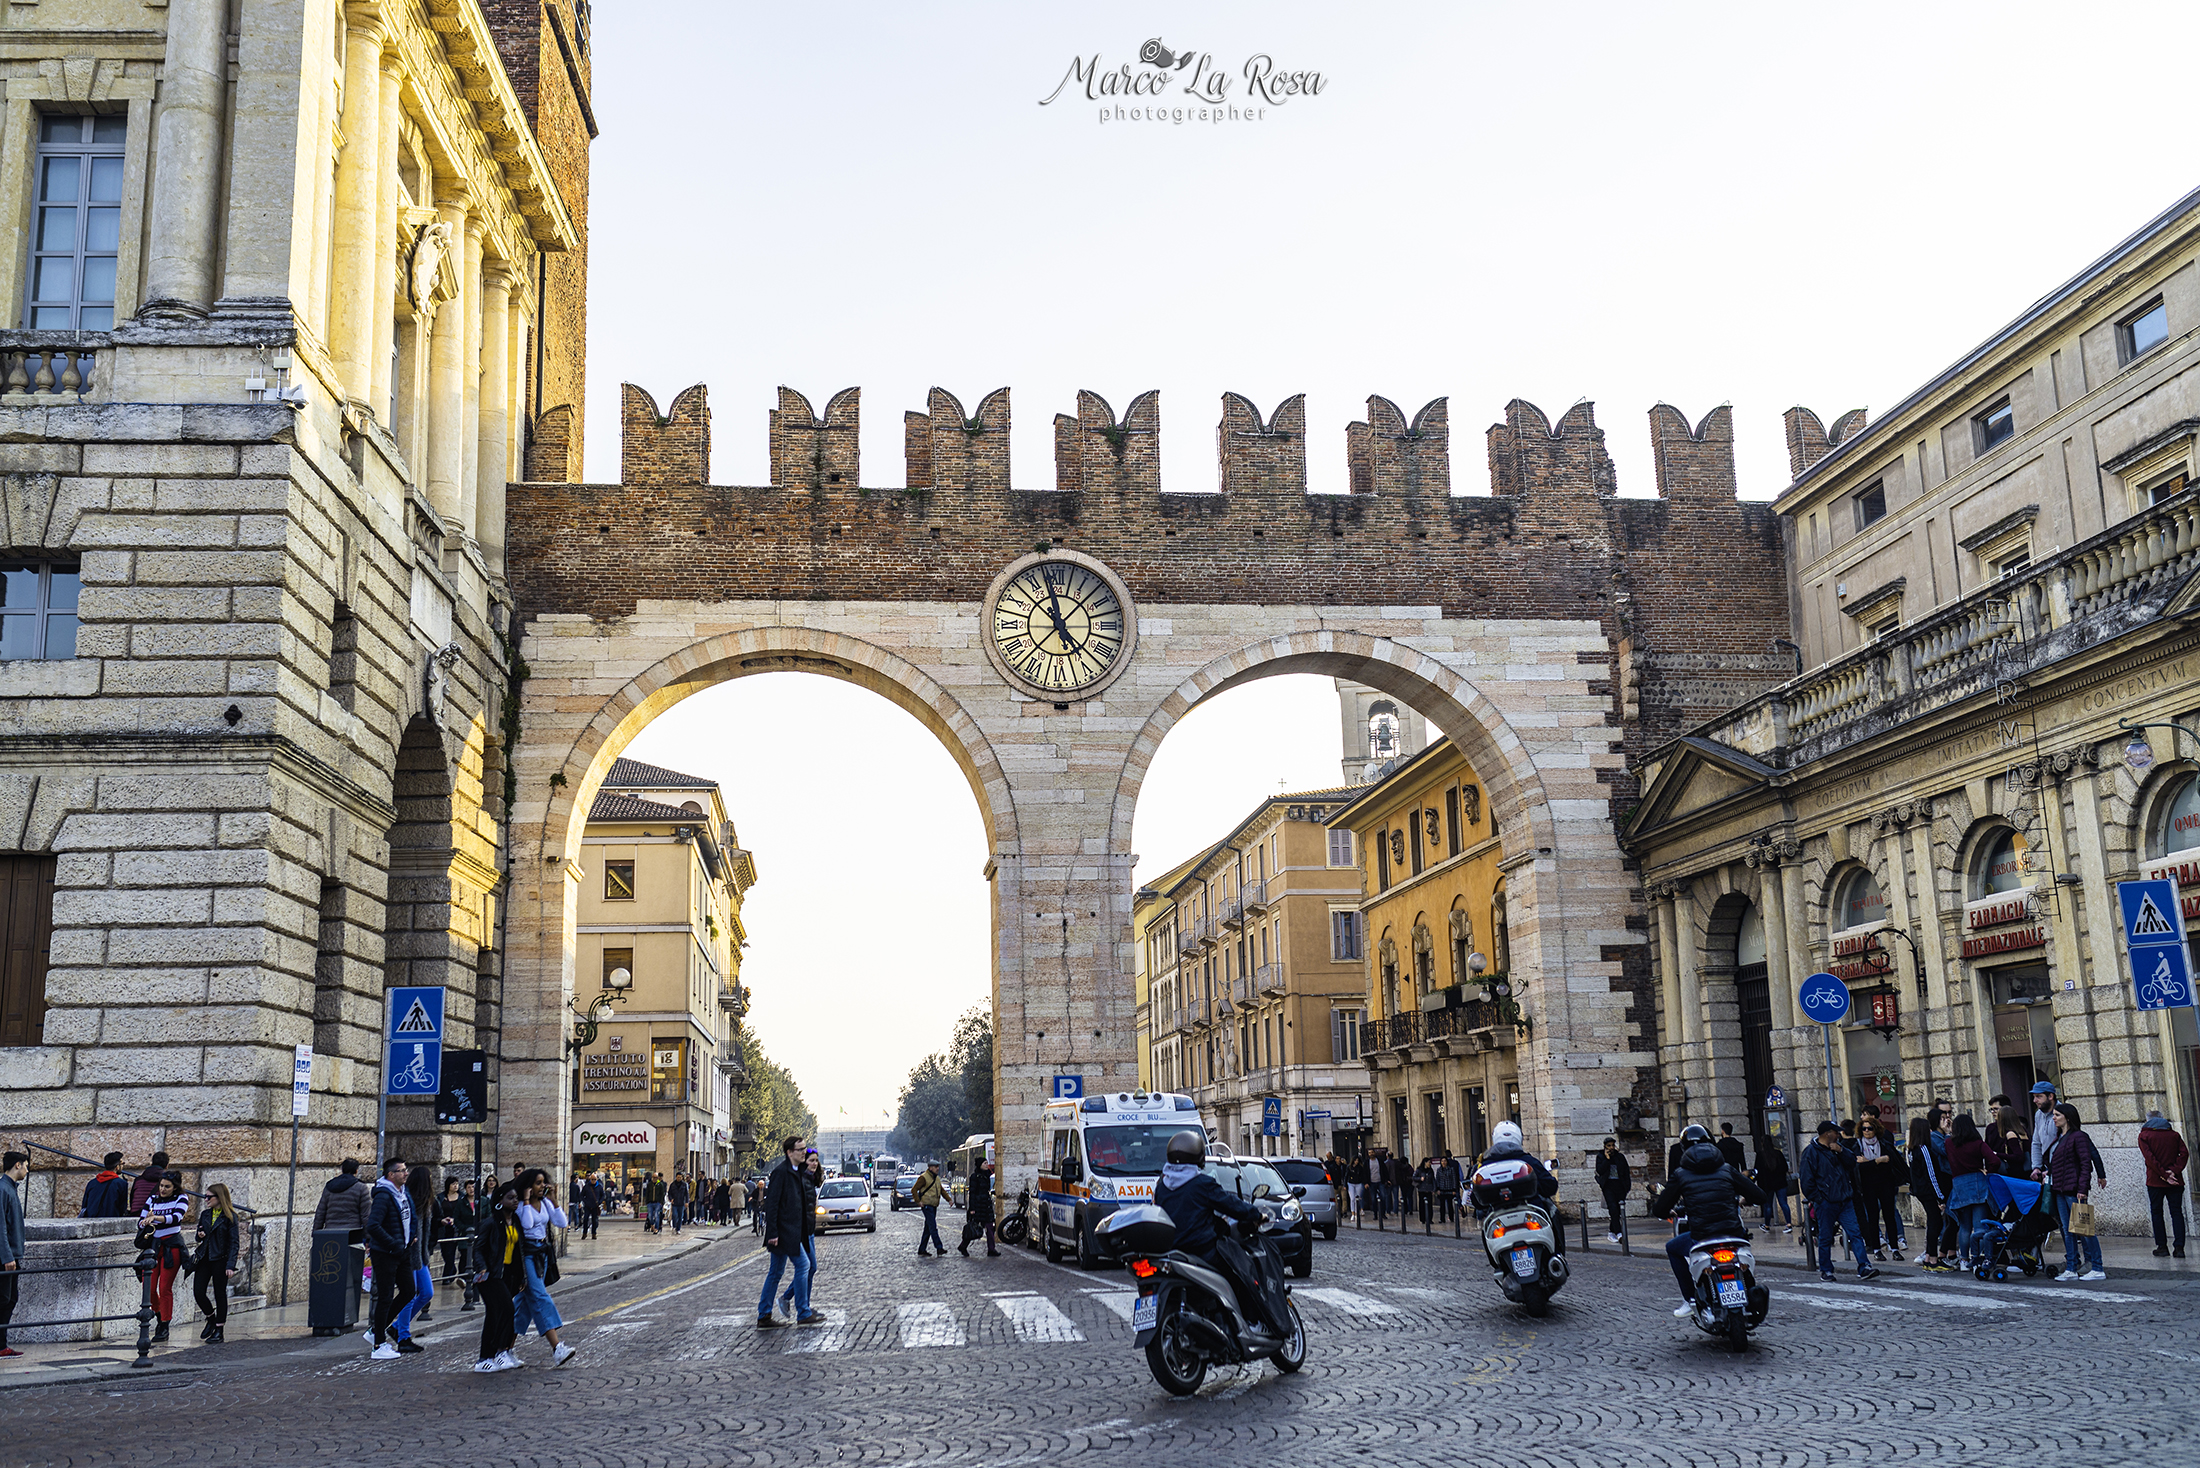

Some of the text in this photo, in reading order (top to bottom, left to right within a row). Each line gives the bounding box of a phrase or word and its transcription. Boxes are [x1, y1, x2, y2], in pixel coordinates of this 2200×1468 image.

[1025, 574, 1042, 592] XI
[1035, 590, 1045, 599] 23
[1053, 586, 1063, 594] 24
[1073, 591, 1081, 600] 13
[1006, 594, 1024, 608] X
[1093, 596, 1110, 609] II
[1022, 603, 1032, 612] 22
[1086, 604, 1095, 612] 14
[1001, 619, 1018, 630] IX
[1018, 620, 1027, 629] 21
[1092, 622, 1100, 630] 15
[1100, 621, 1117, 631] III
[1022, 639, 1033, 648] 20
[1088, 640, 1096, 648] 16
[1037, 652, 1046, 661] 19
[1056, 657, 1064, 665] 18
[1081, 661, 1094, 676] V
[1815, 776, 1872, 808] COELORVM
[2083, 660, 2187, 712] CONCENTVM
[1969, 900, 2025, 927] FARMACIA
[1962, 926, 2045, 957] INTERNAZIONALE
[585, 1053, 646, 1064] ISTITUTO
[660, 1052, 673, 1064] ig
[584, 1067, 633, 1078] TRENTINO
[584, 1080, 648, 1091] ASSICURAZIONI
[1059, 1078, 1077, 1098] P
[580, 1130, 649, 1145] Prénatal
